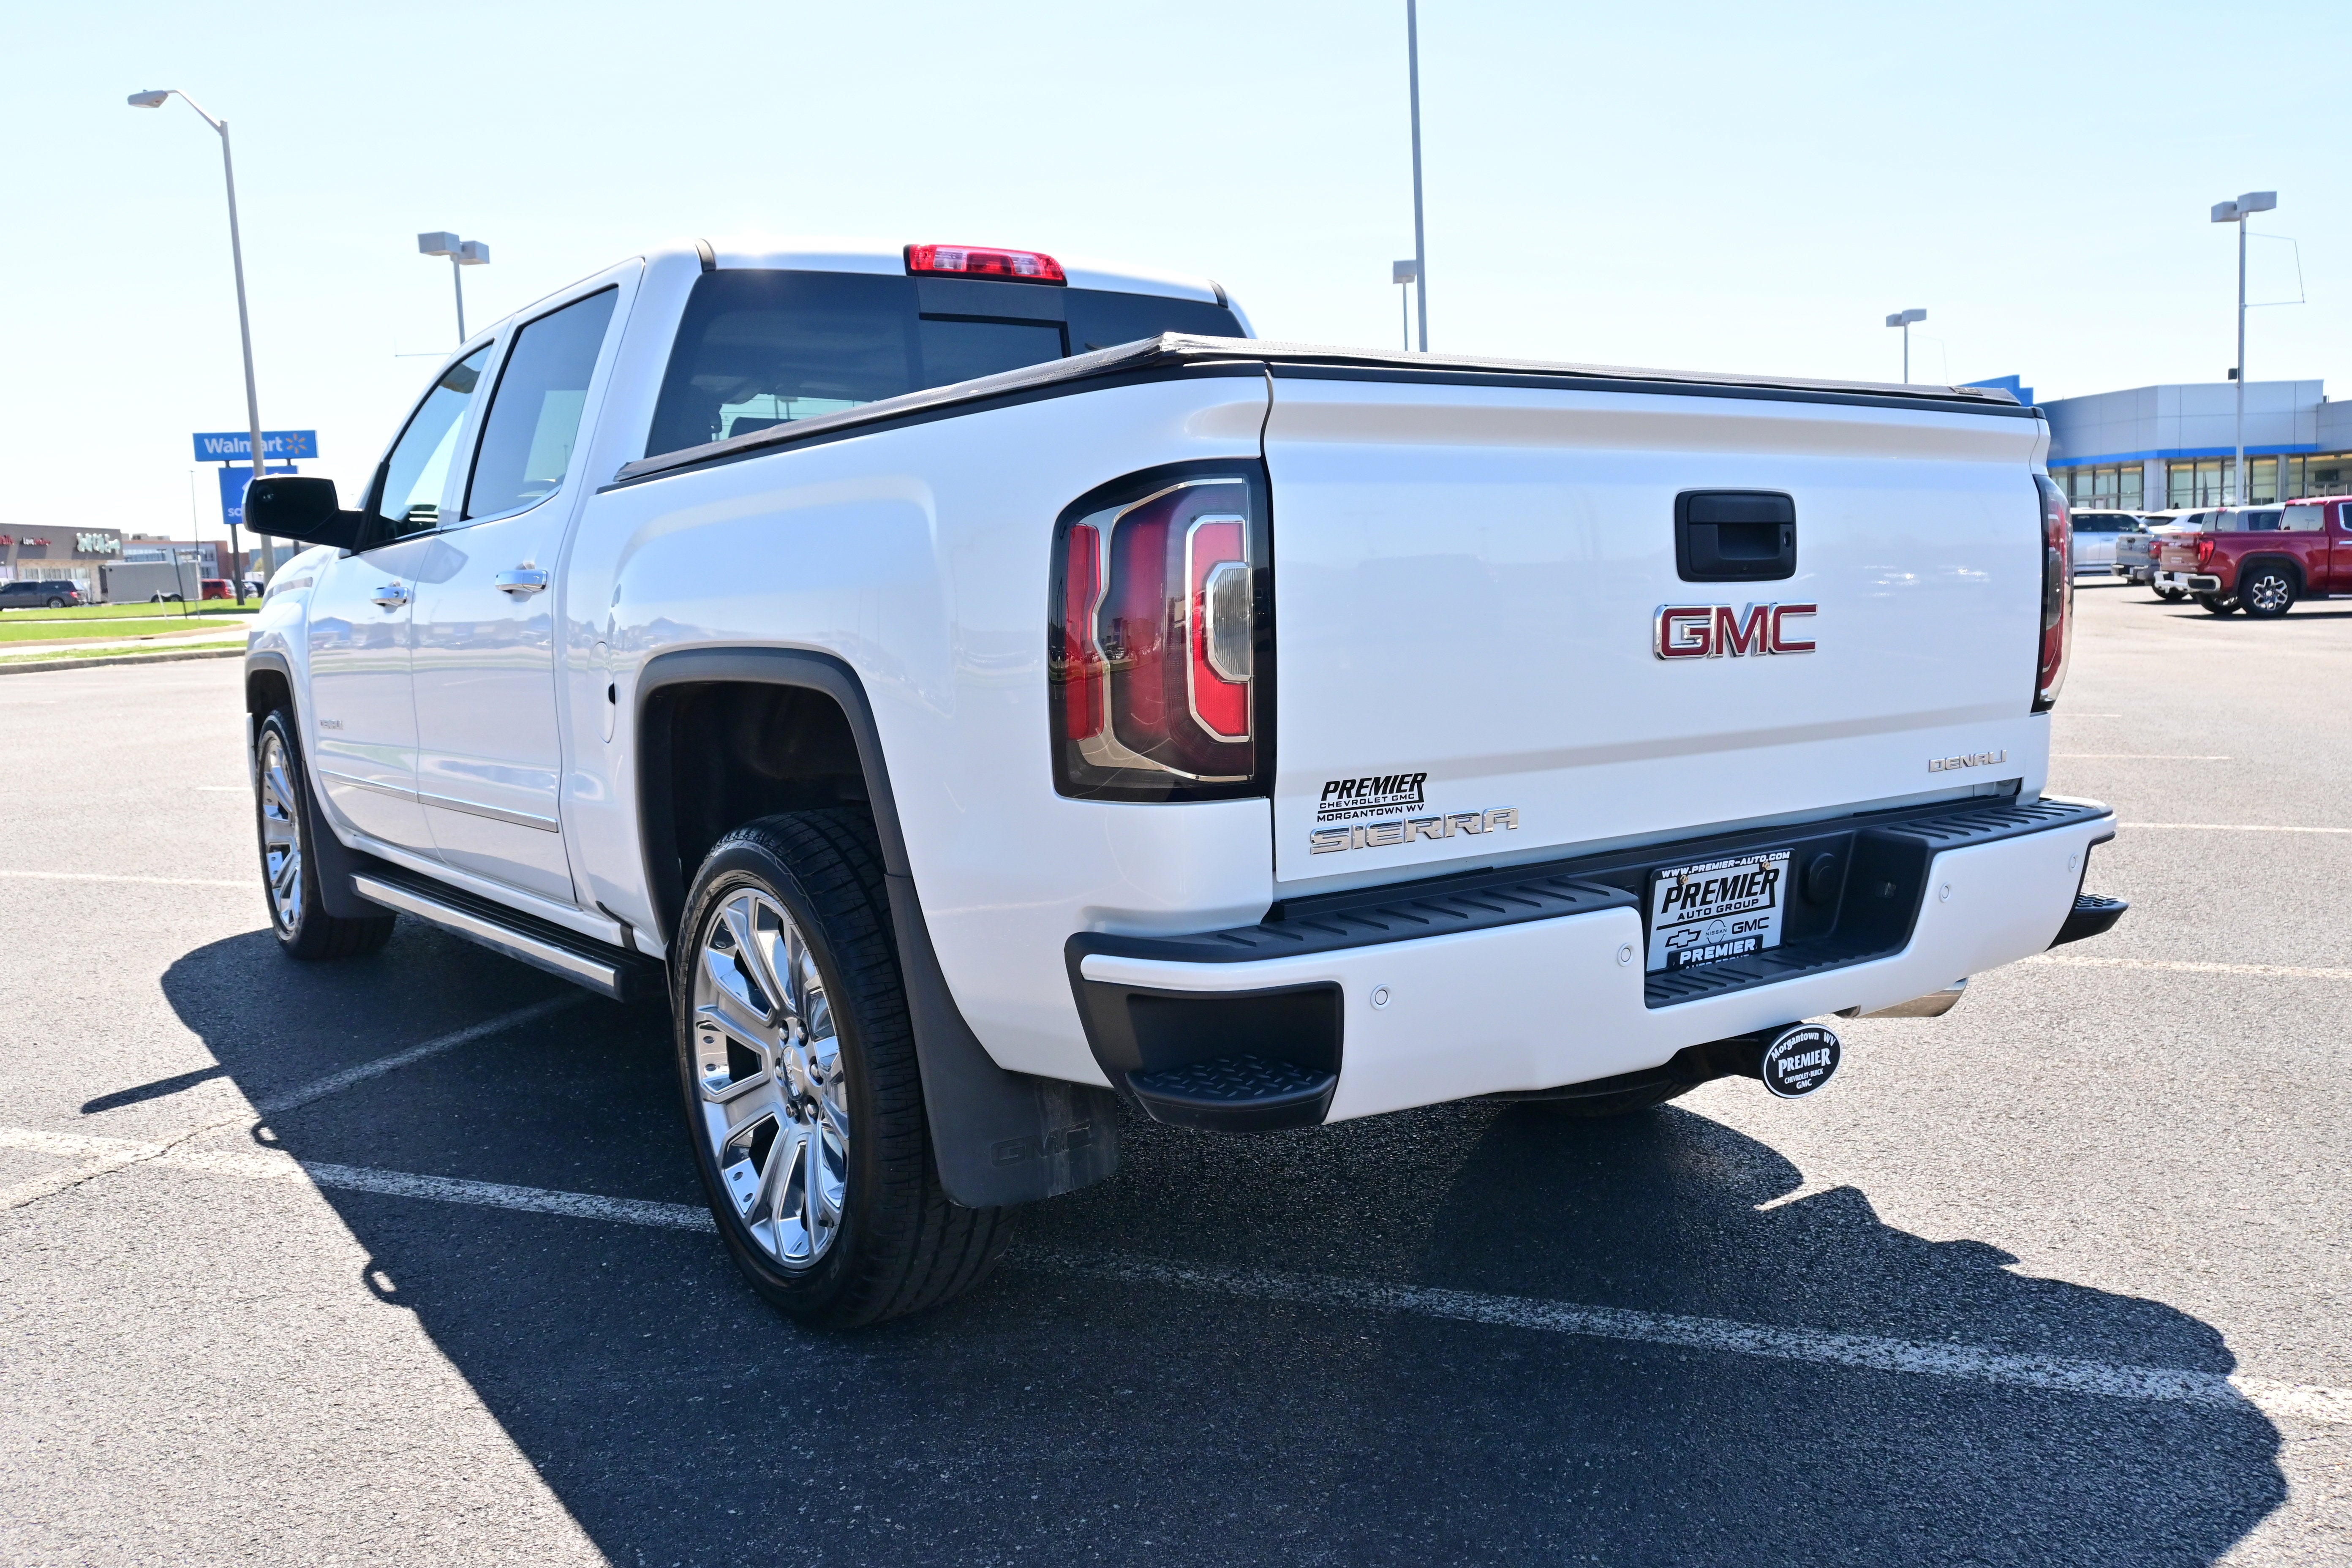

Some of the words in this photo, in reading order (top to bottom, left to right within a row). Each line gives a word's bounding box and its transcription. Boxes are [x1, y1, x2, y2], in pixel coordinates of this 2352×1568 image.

[1653, 602, 1818, 660] GMC
[1928, 750, 2006, 773] DENALI
[1319, 796, 1387, 809] CHEVROLET
[1391, 793, 1415, 801] GMC
[1321, 772, 1427, 803] PREMIER
[1317, 806, 1403, 822] MORGANTOWN
[1406, 803, 1424, 812] WV
[1310, 805, 1519, 855] SIERRA
[1662, 851, 1790, 878] WWW.PREMIER-AUTO.COM
[1661, 868, 1780, 914] PREMIER
[1677, 907, 1712, 921] AUTO
[1716, 898, 1759, 913] GROUP
[1705, 928, 1727, 936] NISSAN
[1731, 916, 1770, 935] GMC
[1680, 938, 1756, 965] PREMIER
[1771, 1032, 1819, 1062] Morgantown
[1824, 1032, 1836, 1046] WV
[1778, 1048, 1831, 1078] PREMIER
[1797, 1079, 1812, 1089] GMC
[991, 1120, 1091, 1167] GMC
